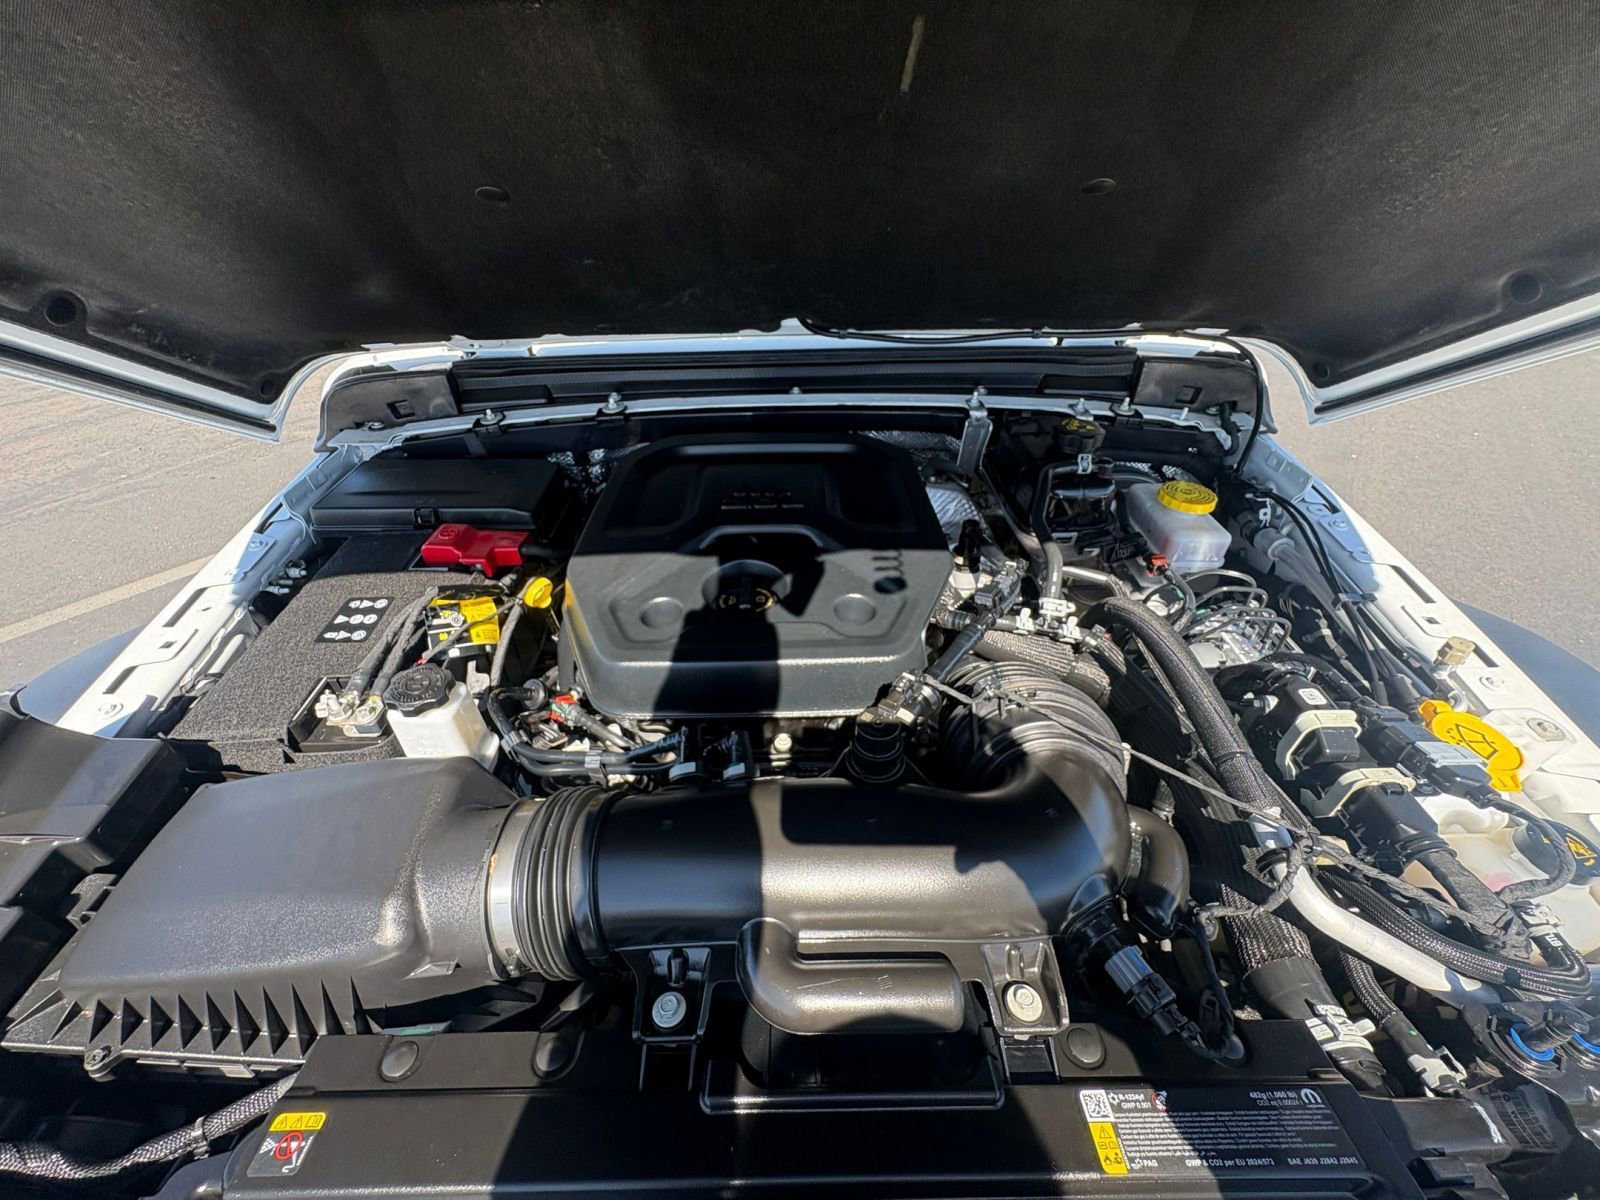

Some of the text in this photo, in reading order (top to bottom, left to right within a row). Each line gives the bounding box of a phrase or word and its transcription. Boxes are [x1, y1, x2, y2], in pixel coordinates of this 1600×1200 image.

[1142, 1159, 1159, 1168] PAG
[1184, 1159, 1202, 1167] GWP
[1202, 1159, 1209, 1167] &
[1208, 1159, 1224, 1167] CO2
[1223, 1159, 1235, 1168] per
[1234, 1158, 1247, 1166] EU
[1287, 1157, 1303, 1166] SAE
